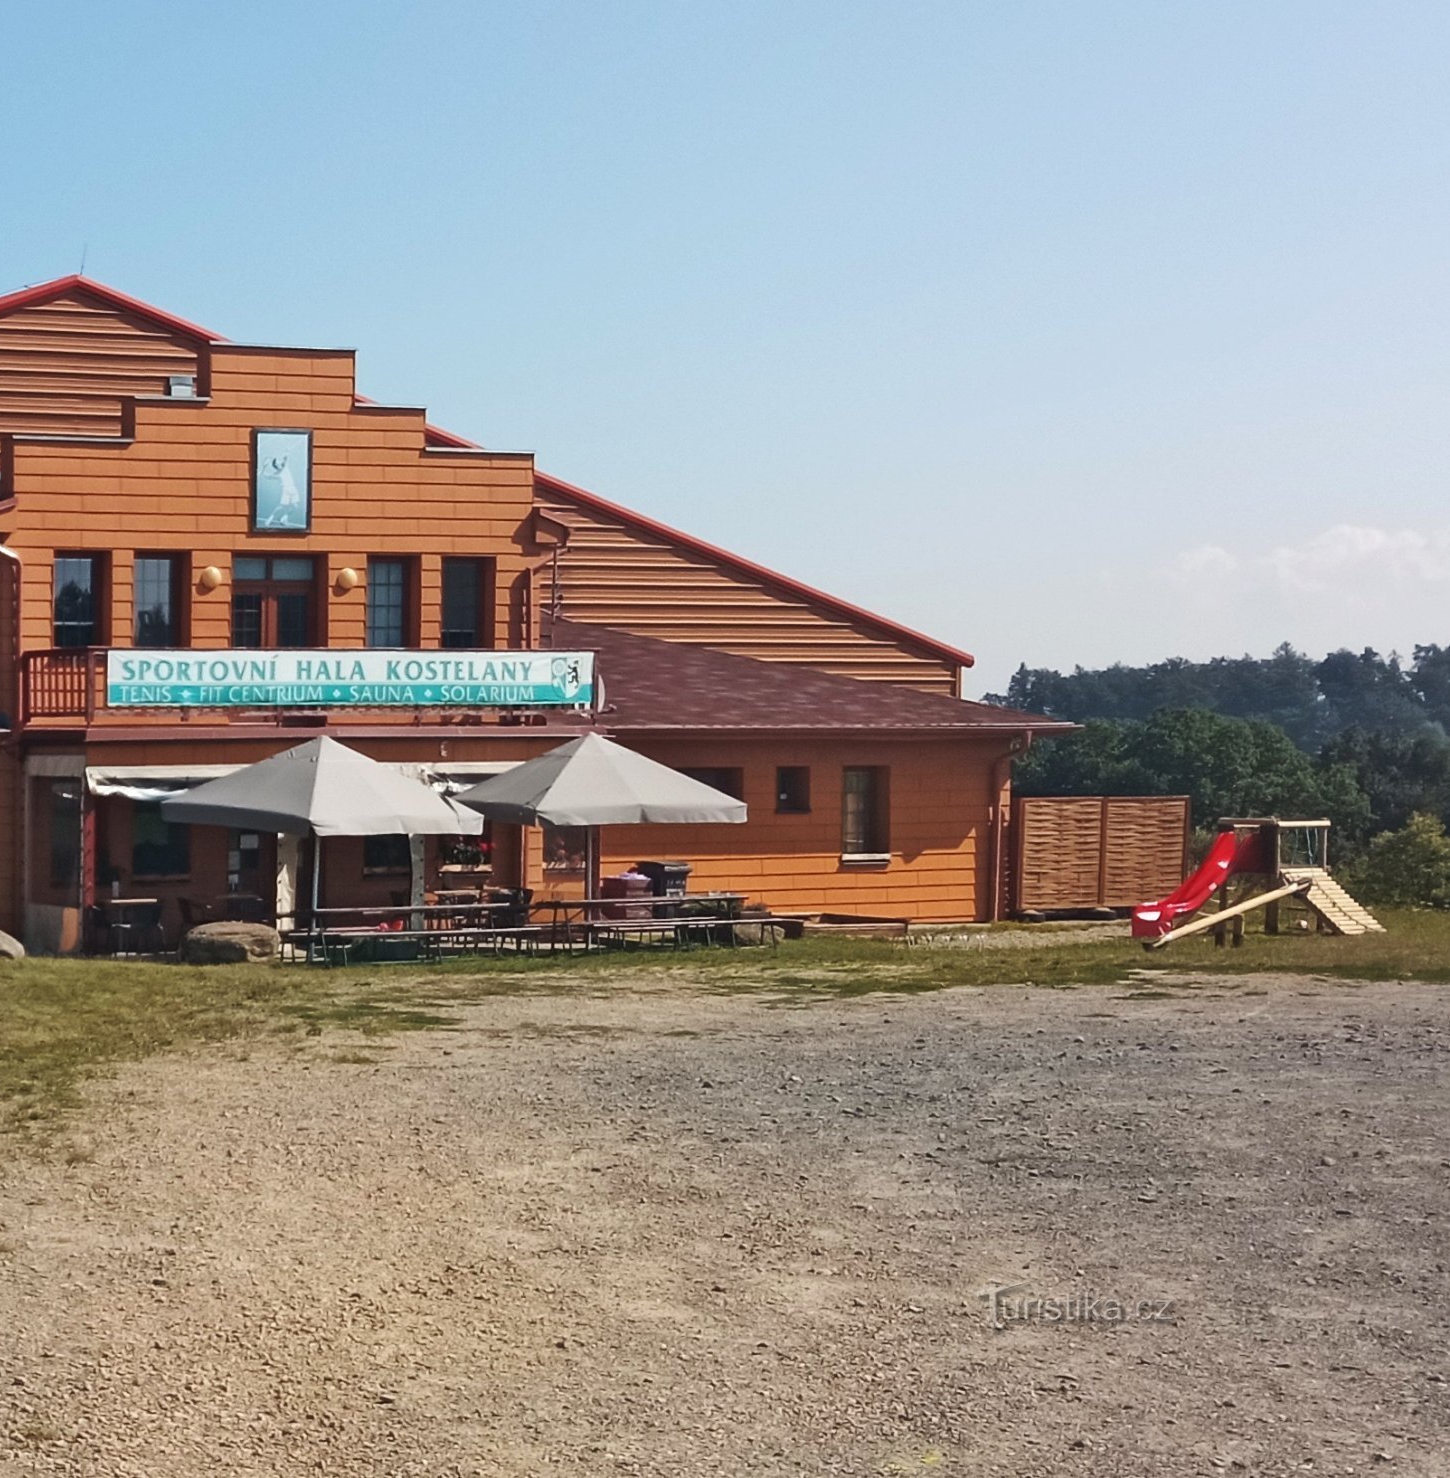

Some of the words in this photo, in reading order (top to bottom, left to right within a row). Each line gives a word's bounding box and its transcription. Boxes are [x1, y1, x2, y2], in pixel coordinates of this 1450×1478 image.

[121, 654, 279, 681] SPORTOVNÍ
[296, 660, 366, 681] HALA
[386, 660, 533, 681] KOSTELANY
[120, 685, 171, 702] TENIS
[200, 685, 223, 701] FIT
[229, 685, 324, 702] CENTRIUM
[350, 685, 415, 702] SAUNA
[440, 685, 535, 702] SOLARIUM
